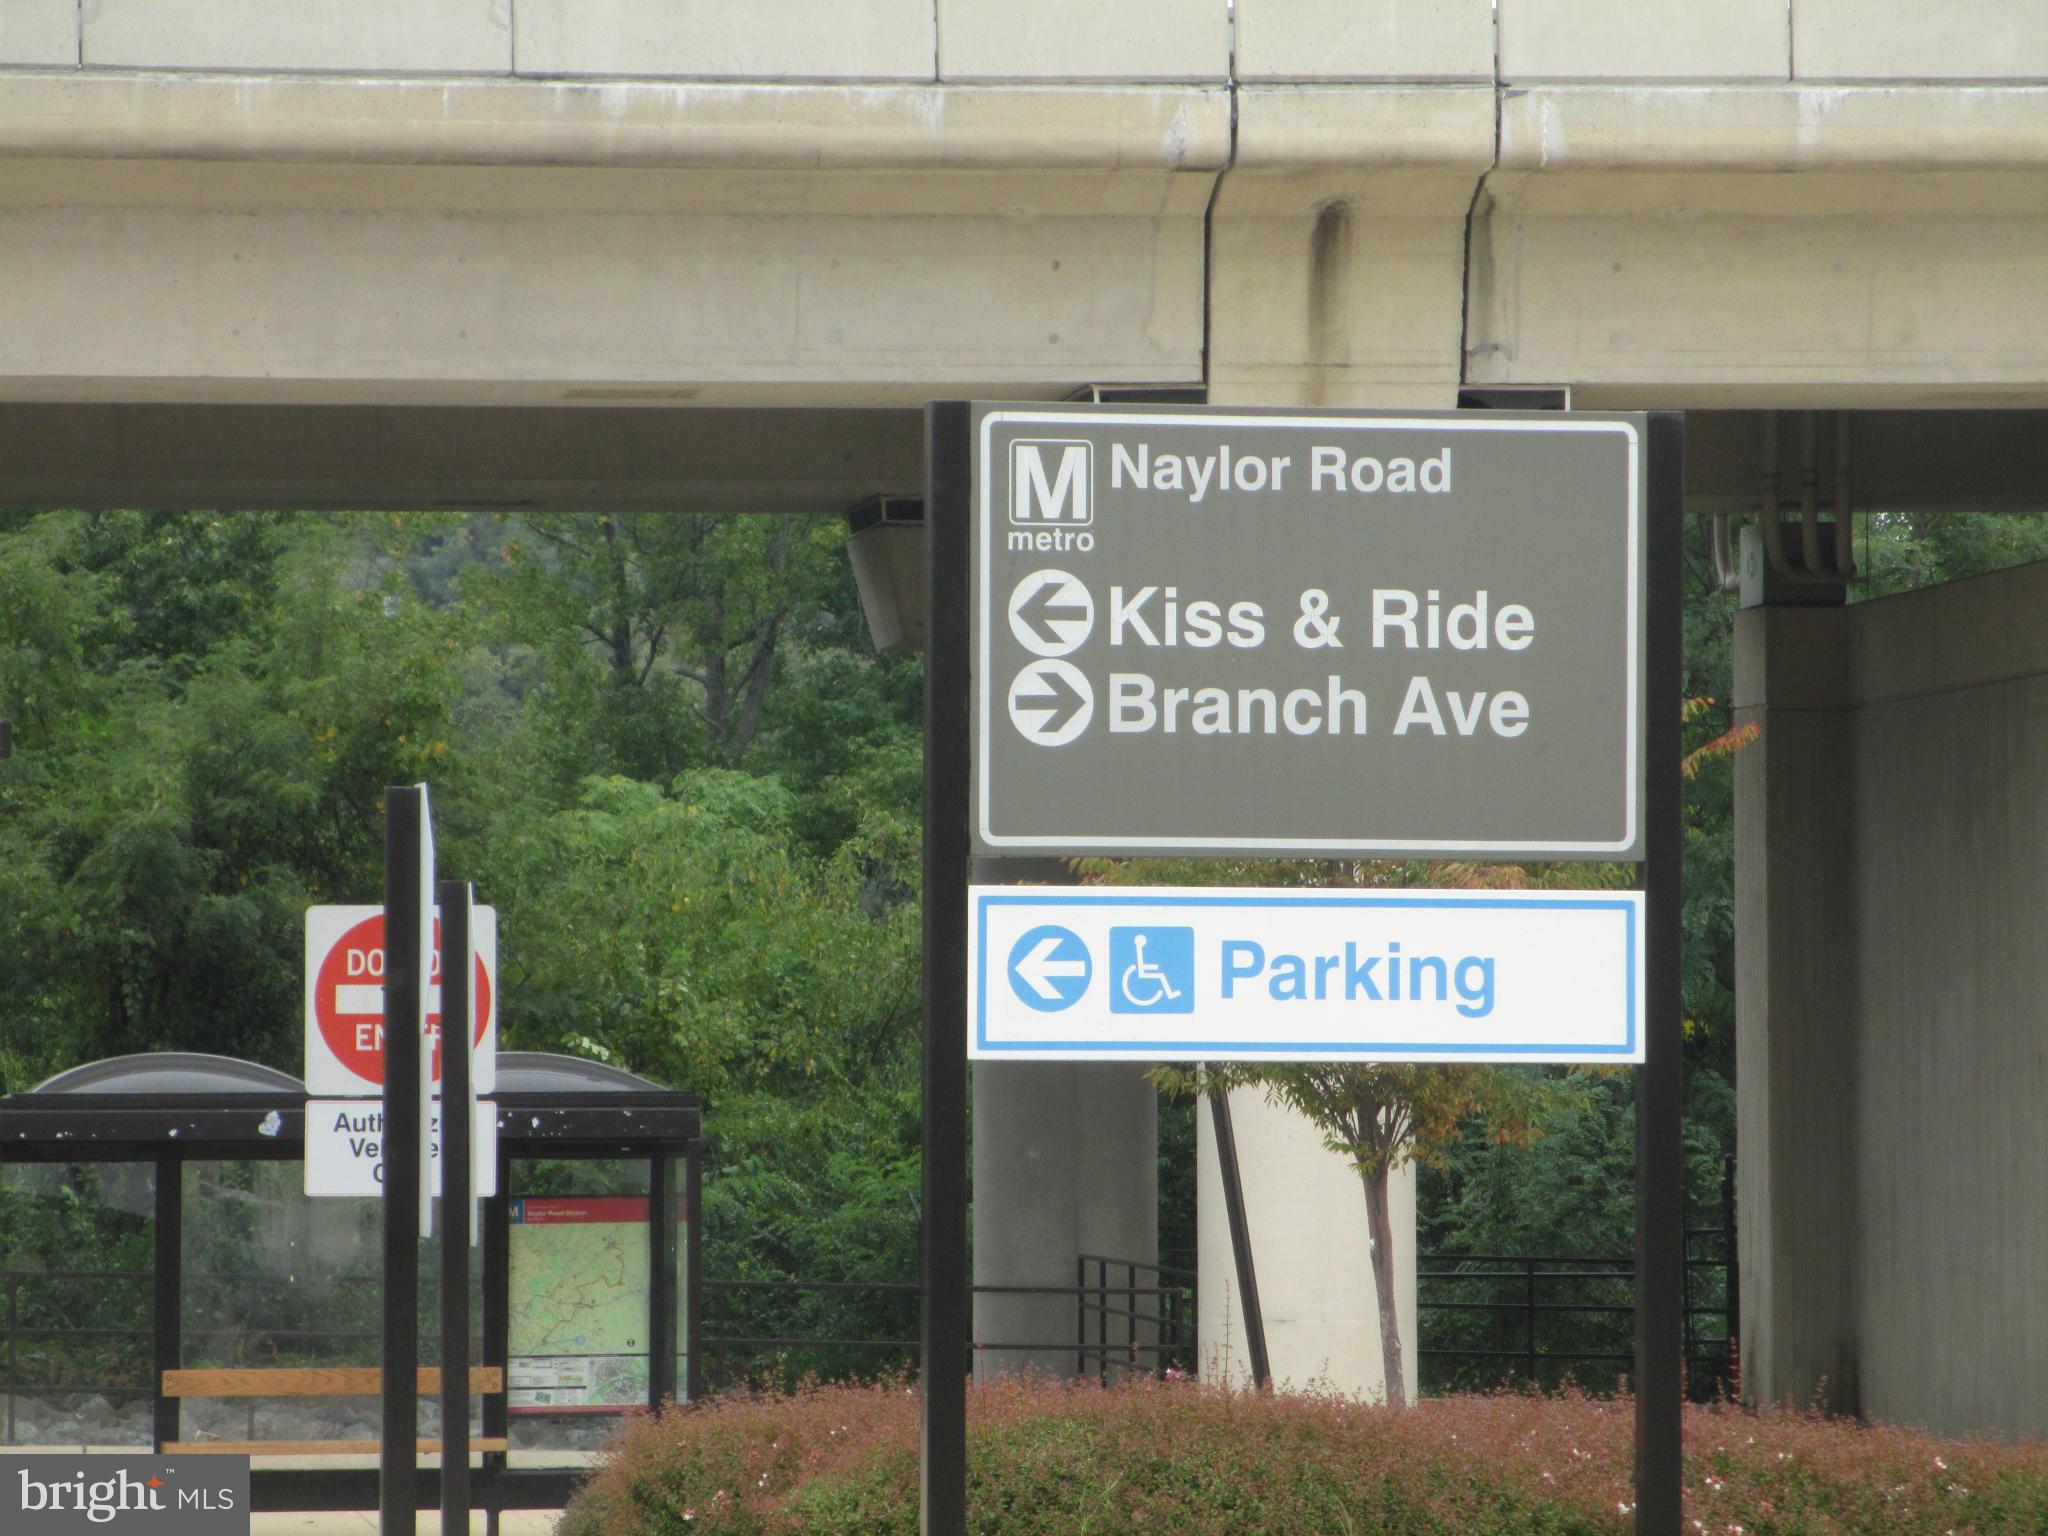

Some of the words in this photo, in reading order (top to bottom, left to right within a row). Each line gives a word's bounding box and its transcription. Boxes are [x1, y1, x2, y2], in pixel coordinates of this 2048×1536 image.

[1014, 445, 1087, 520] M
[1111, 443, 1291, 503] Naylor
[1311, 446, 1452, 493] Road
[1008, 527, 1095, 552] metro
[1109, 586, 1266, 648] Kiss
[1293, 588, 1344, 649] &
[1372, 589, 1535, 651] Ride
[1109, 673, 1367, 736] Branch
[1393, 676, 1531, 738] Ave
[346, 948, 384, 976] DO
[1221, 939, 1496, 1018] Parking
